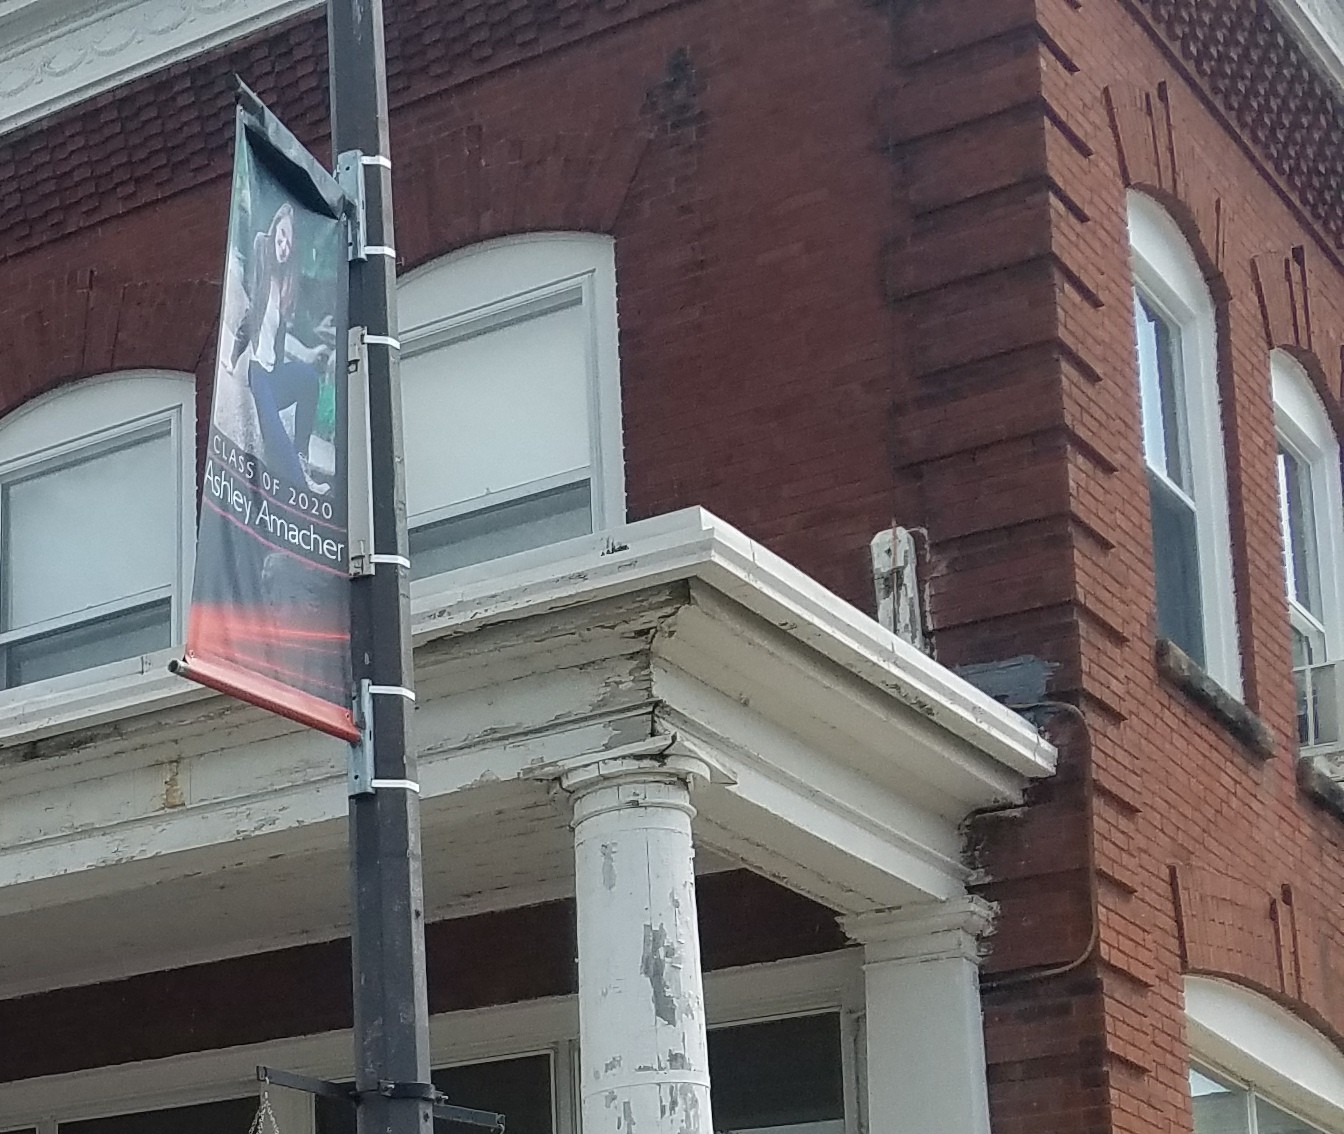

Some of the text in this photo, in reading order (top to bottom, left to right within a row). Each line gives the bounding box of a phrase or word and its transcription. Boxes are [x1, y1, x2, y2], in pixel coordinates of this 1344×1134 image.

[204, 459, 345, 562] Ashley Amacher
[213, 434, 333, 520] CLASS OF 2020
